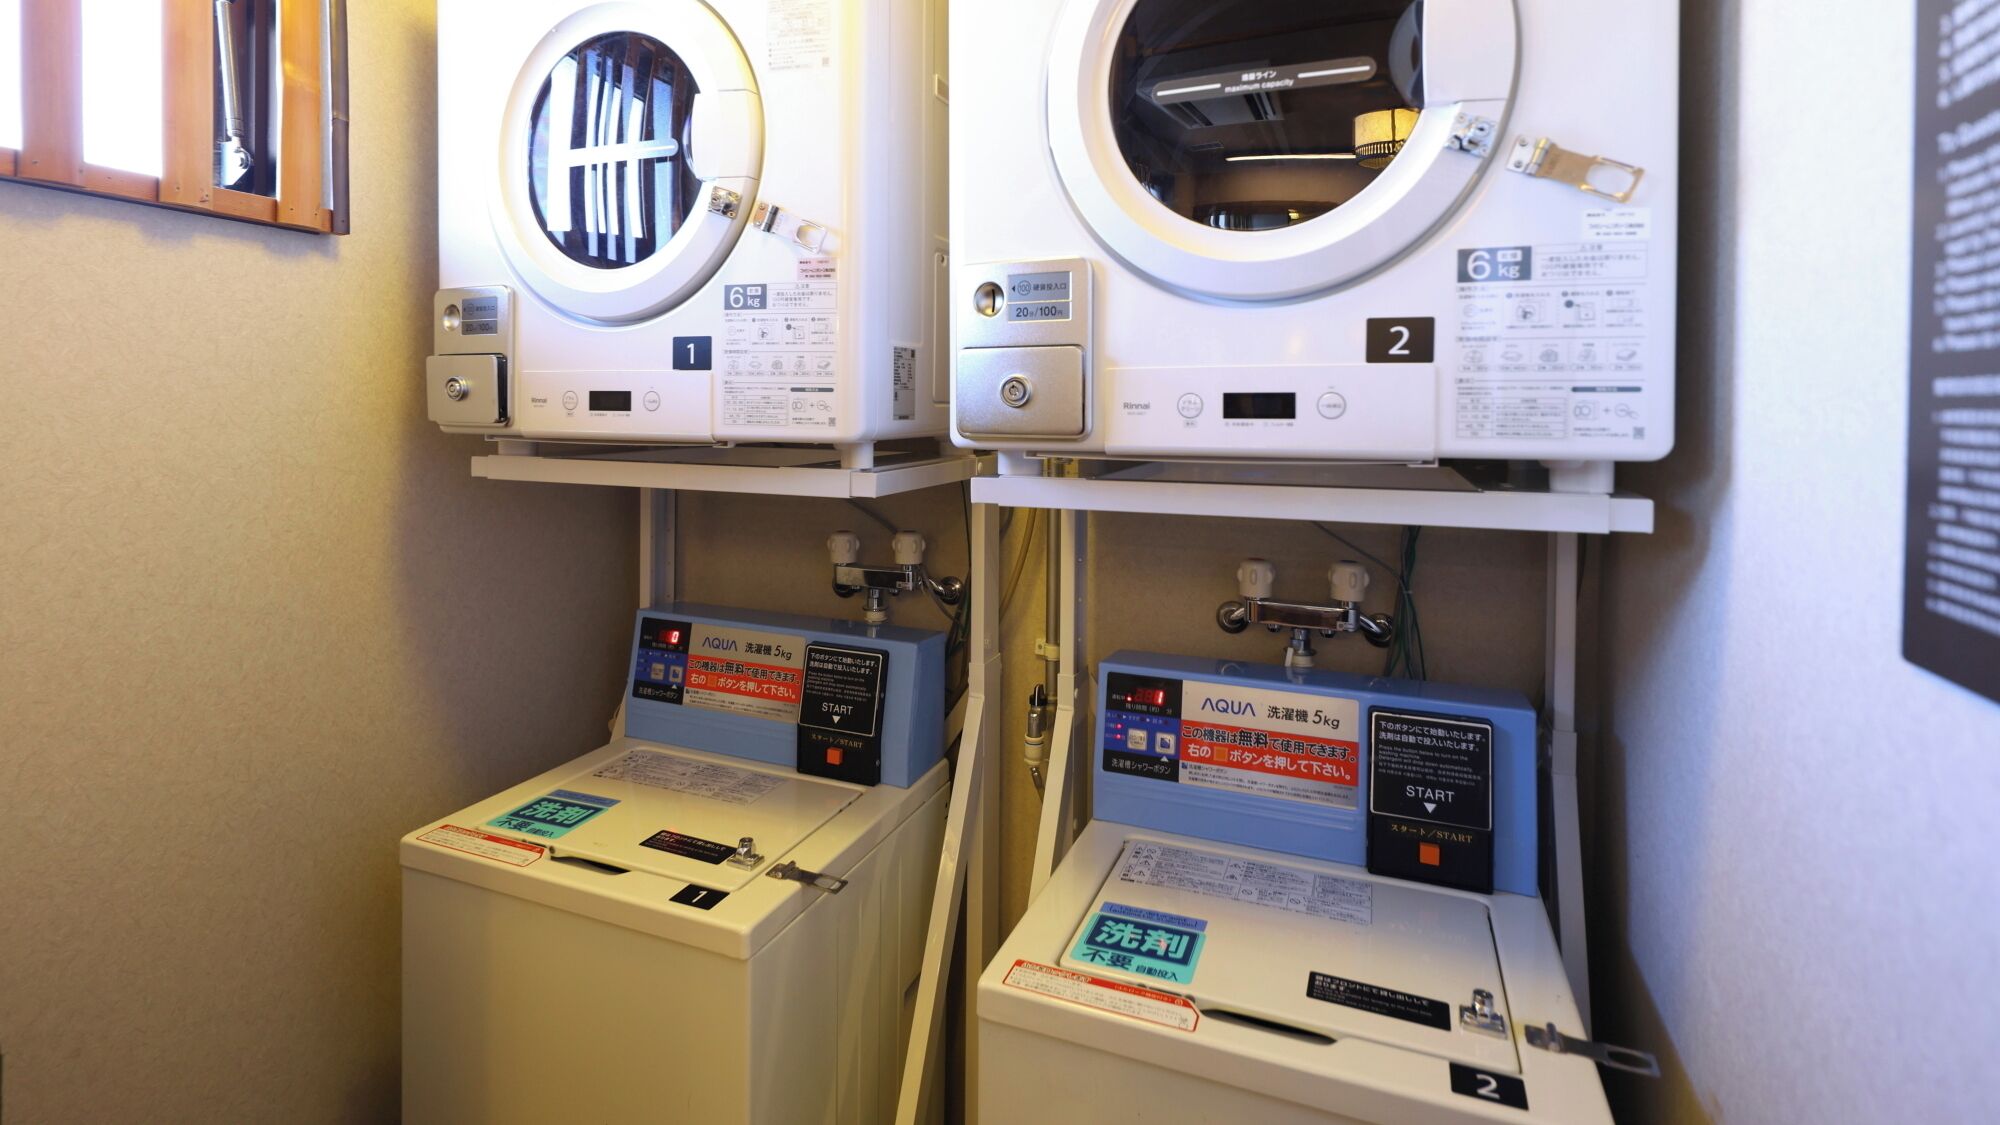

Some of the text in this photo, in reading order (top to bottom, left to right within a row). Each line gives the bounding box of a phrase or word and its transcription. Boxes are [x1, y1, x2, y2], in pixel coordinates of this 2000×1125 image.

[1224, 79, 1294, 93] maximum capacity
[1466, 251, 1491, 280] 6
[1498, 264, 1520, 279] kg
[730, 287, 744, 308] 6
[747, 297, 760, 308] kg
[1388, 326, 1410, 355] 2
[687, 343, 695, 365] 1
[1123, 402, 1151, 410] Rinnai
[671, 631, 680, 643] 0
[702, 636, 793, 661] AQUA 洗濯機 5kg
[688, 660, 799, 685] この機器は無料で使用できます。
[822, 702, 854, 716] START
[1201, 697, 1340, 730] AQUA 洗濯機 5kg
[1379, 720, 1486, 742] 下のボタンにて始動いたします。
[1379, 731, 1480, 753] 洗剤は自動で投入いたします。
[1182, 725, 1356, 763] この機器は無料で使用できます。
[1187, 743, 1211, 759] 右の
[1229, 749, 1351, 781] ボタンを押して下さい。
[1406, 785, 1455, 803] START
[519, 800, 596, 824] 洗剤
[692, 890, 708, 903] 1
[1095, 920, 1190, 959] 洗剤
[1082, 947, 1135, 970] 不要
[1135, 964, 1179, 982] 自動投入
[1475, 1074, 1500, 1100] 2
